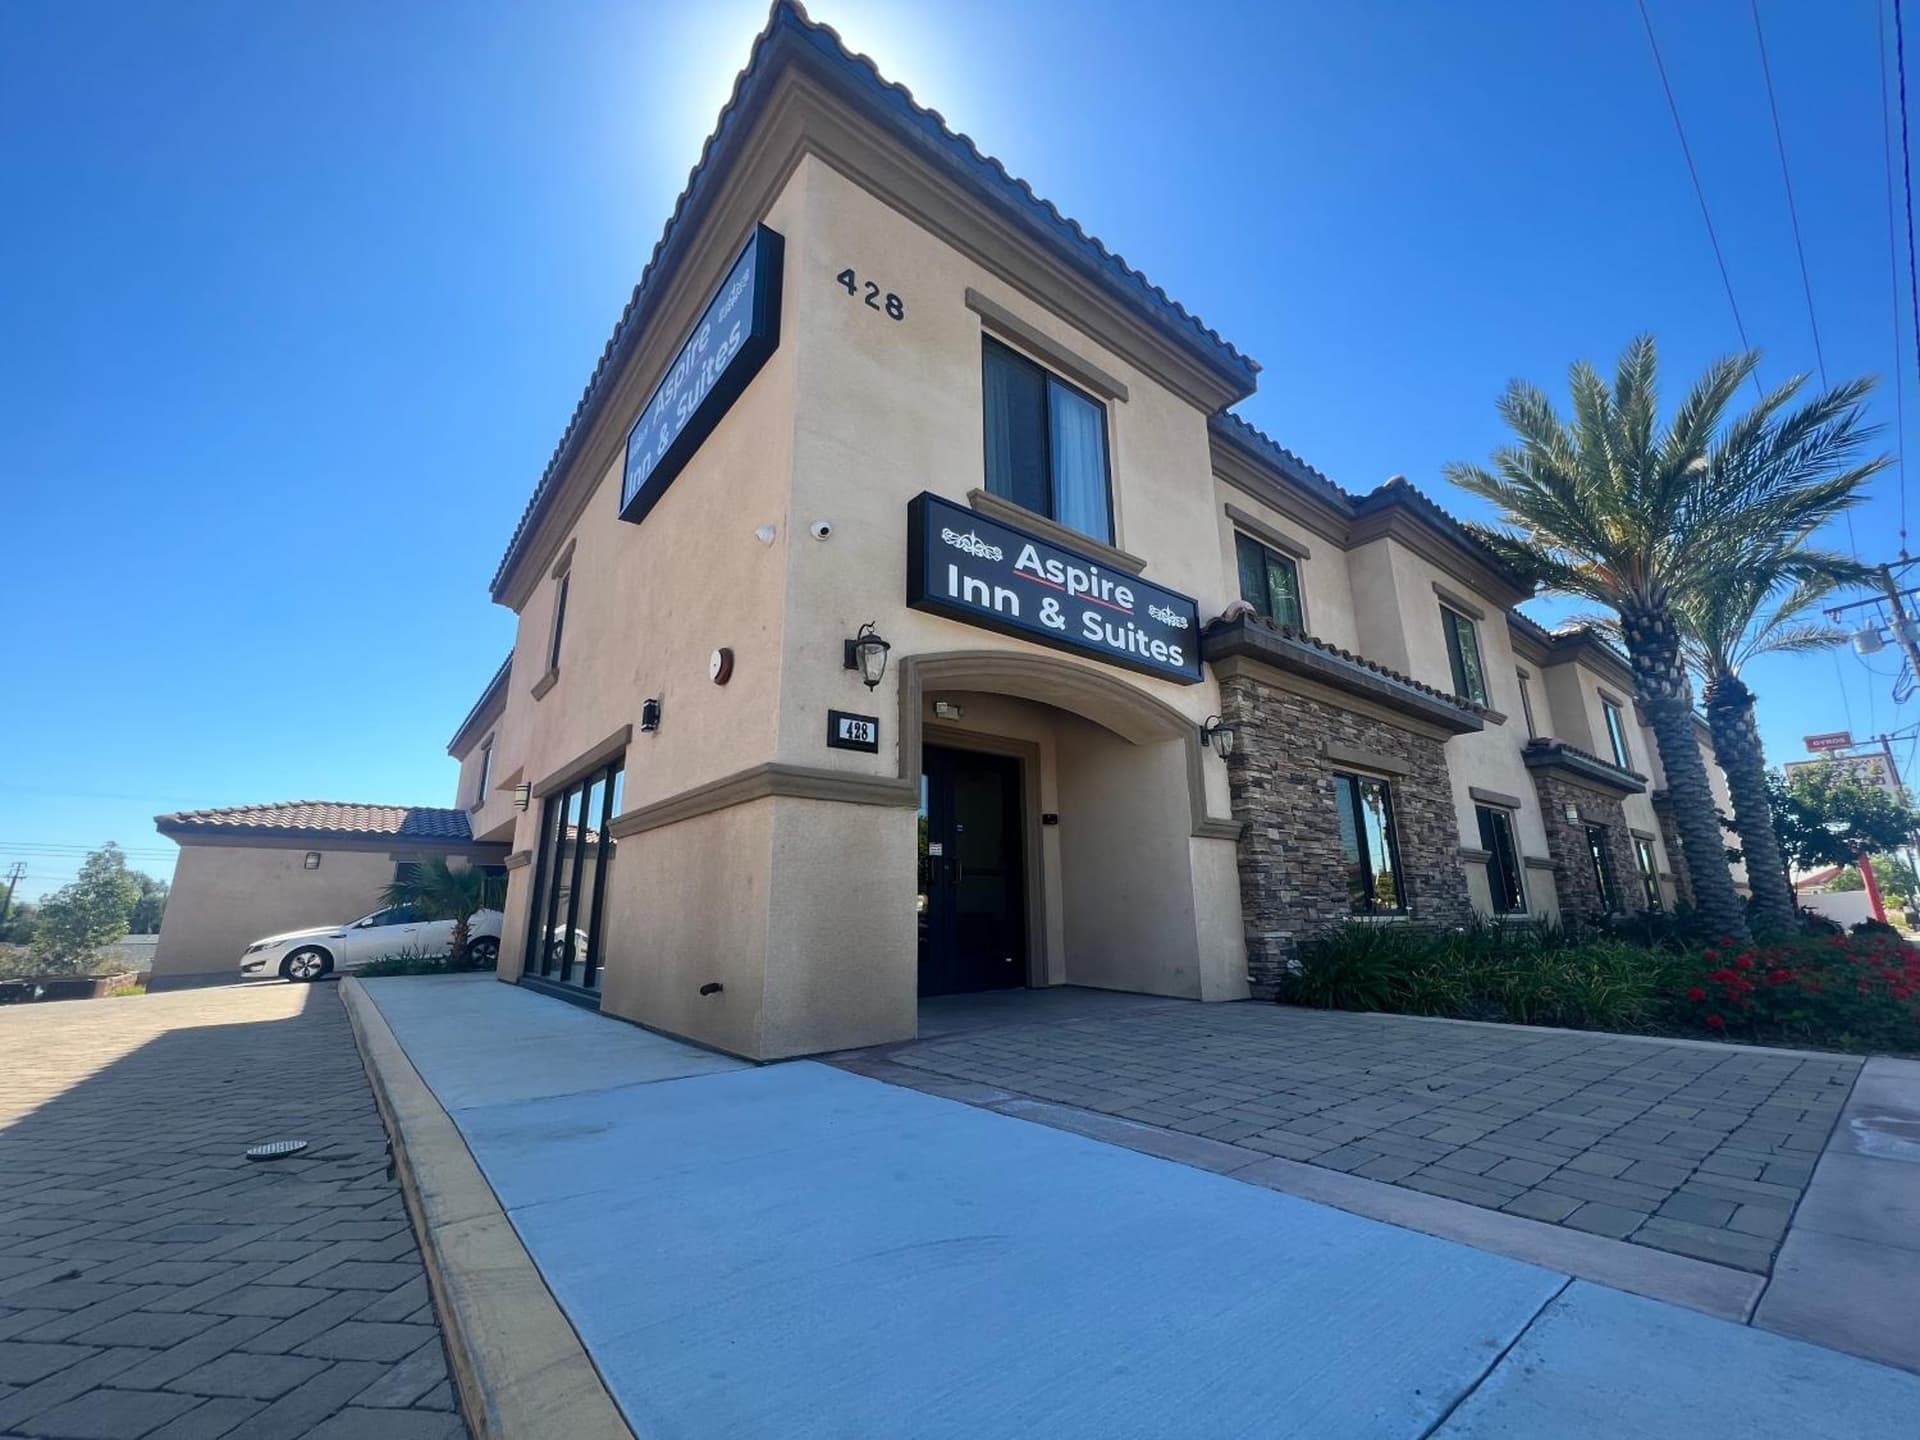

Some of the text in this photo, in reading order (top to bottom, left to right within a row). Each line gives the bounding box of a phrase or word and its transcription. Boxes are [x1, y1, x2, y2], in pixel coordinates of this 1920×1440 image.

[837, 268, 904, 321] 428
[627, 320, 742, 499] Inn & Suites
[653, 322, 711, 425] Aspire
[948, 563, 1184, 667] Inn & Suites
[1014, 543, 1135, 609] Aspire
[846, 721, 869, 741] 428
